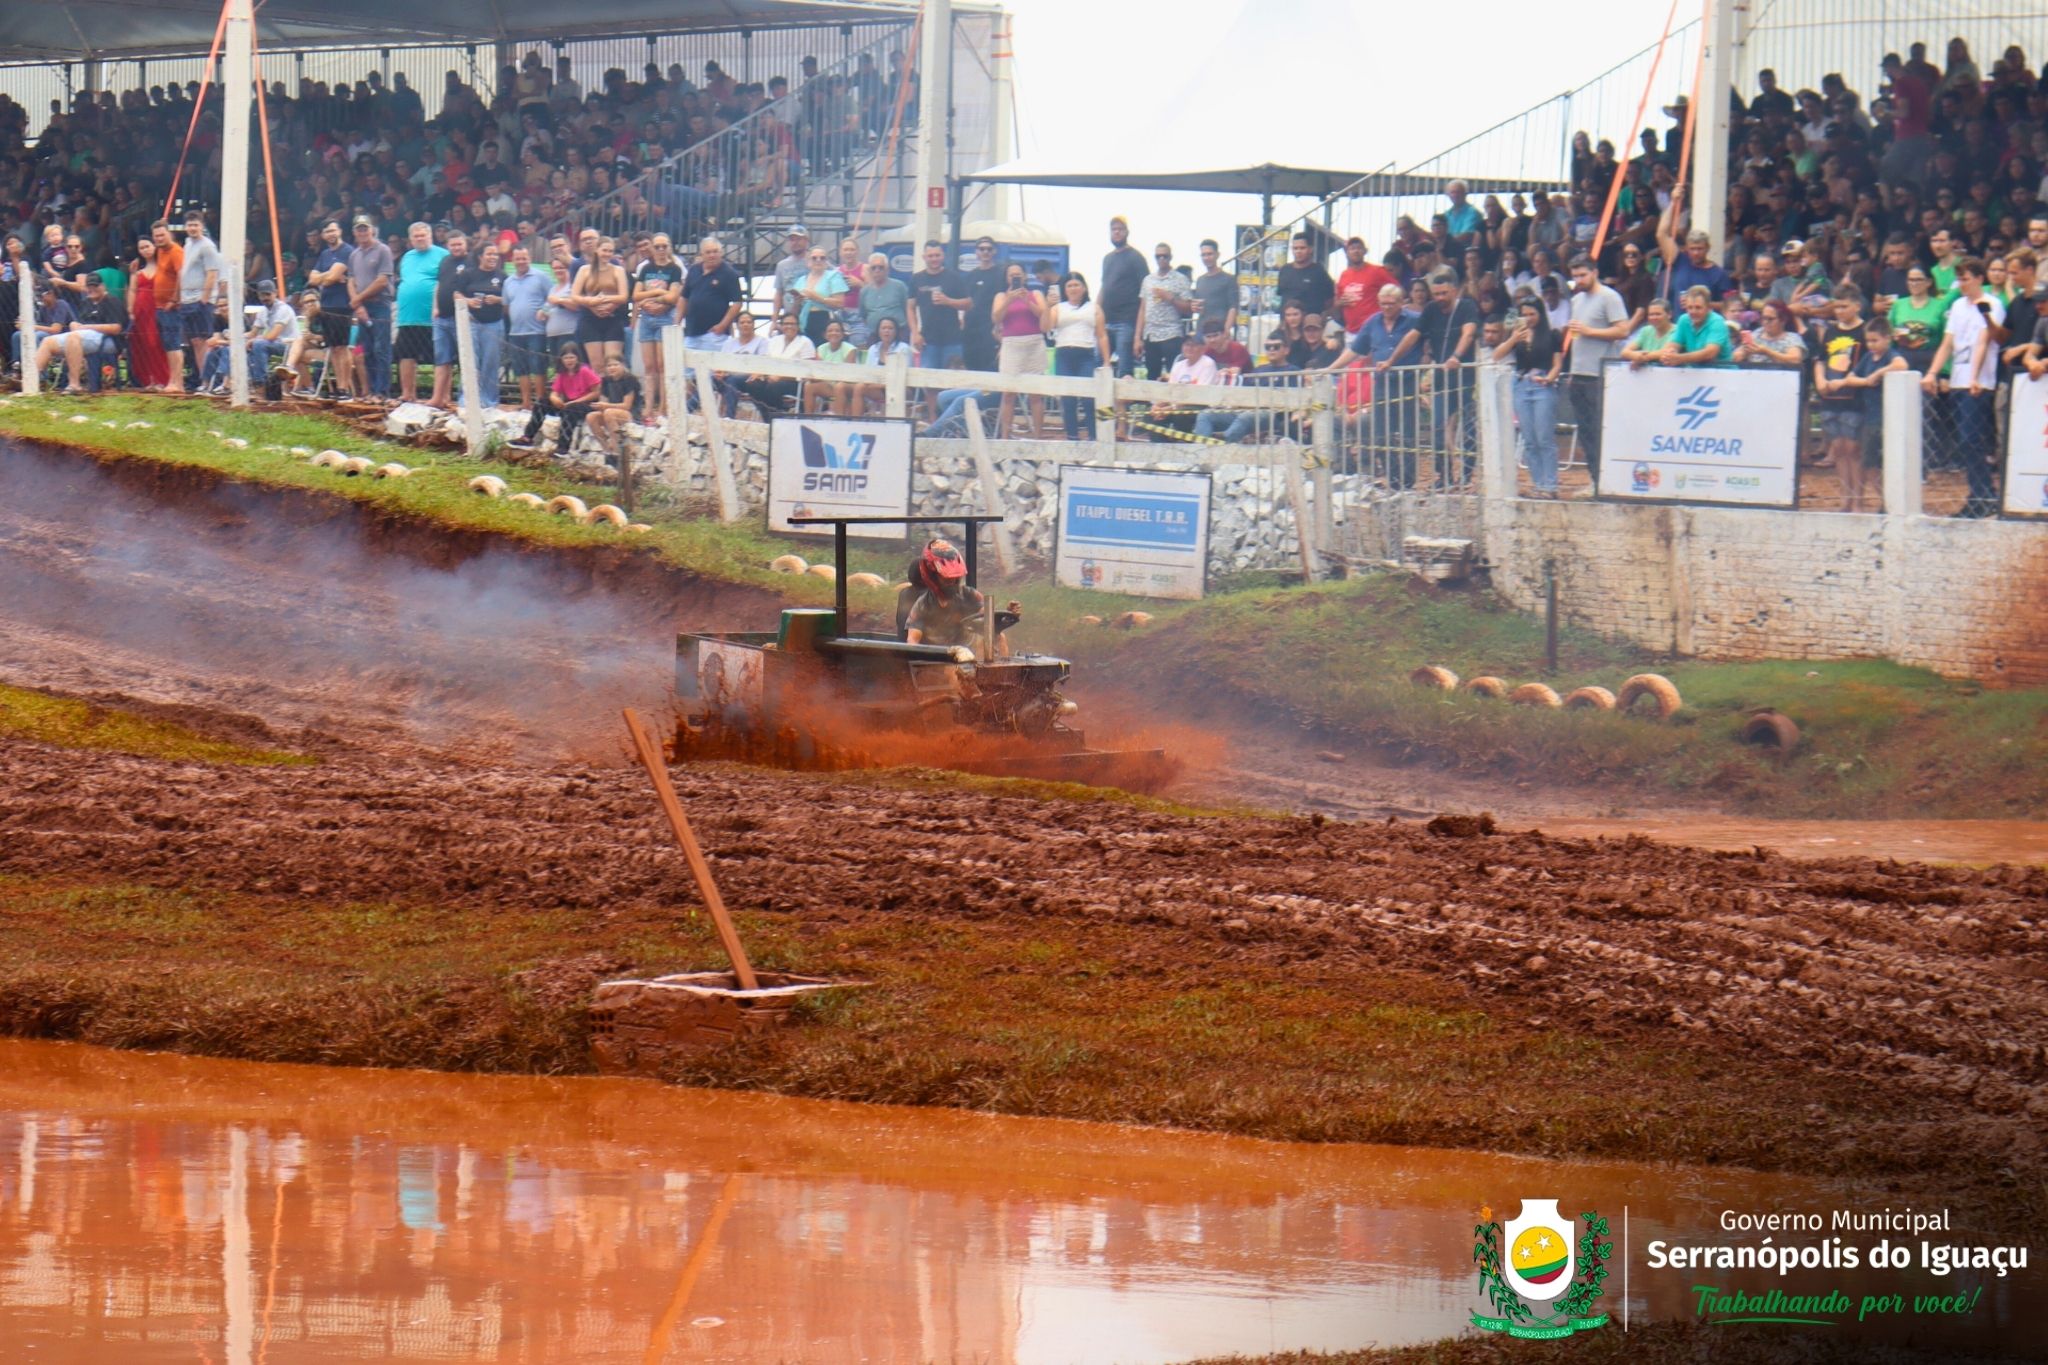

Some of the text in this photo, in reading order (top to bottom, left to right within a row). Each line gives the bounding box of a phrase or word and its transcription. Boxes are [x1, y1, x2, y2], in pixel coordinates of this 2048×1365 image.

[847, 432, 876, 470] 27
[1651, 435, 1743, 456] SANEPAR
[803, 472, 868, 492] SAMP
[1076, 504, 1113, 520] ITAIPU
[1115, 507, 1153, 523] DIESEL
